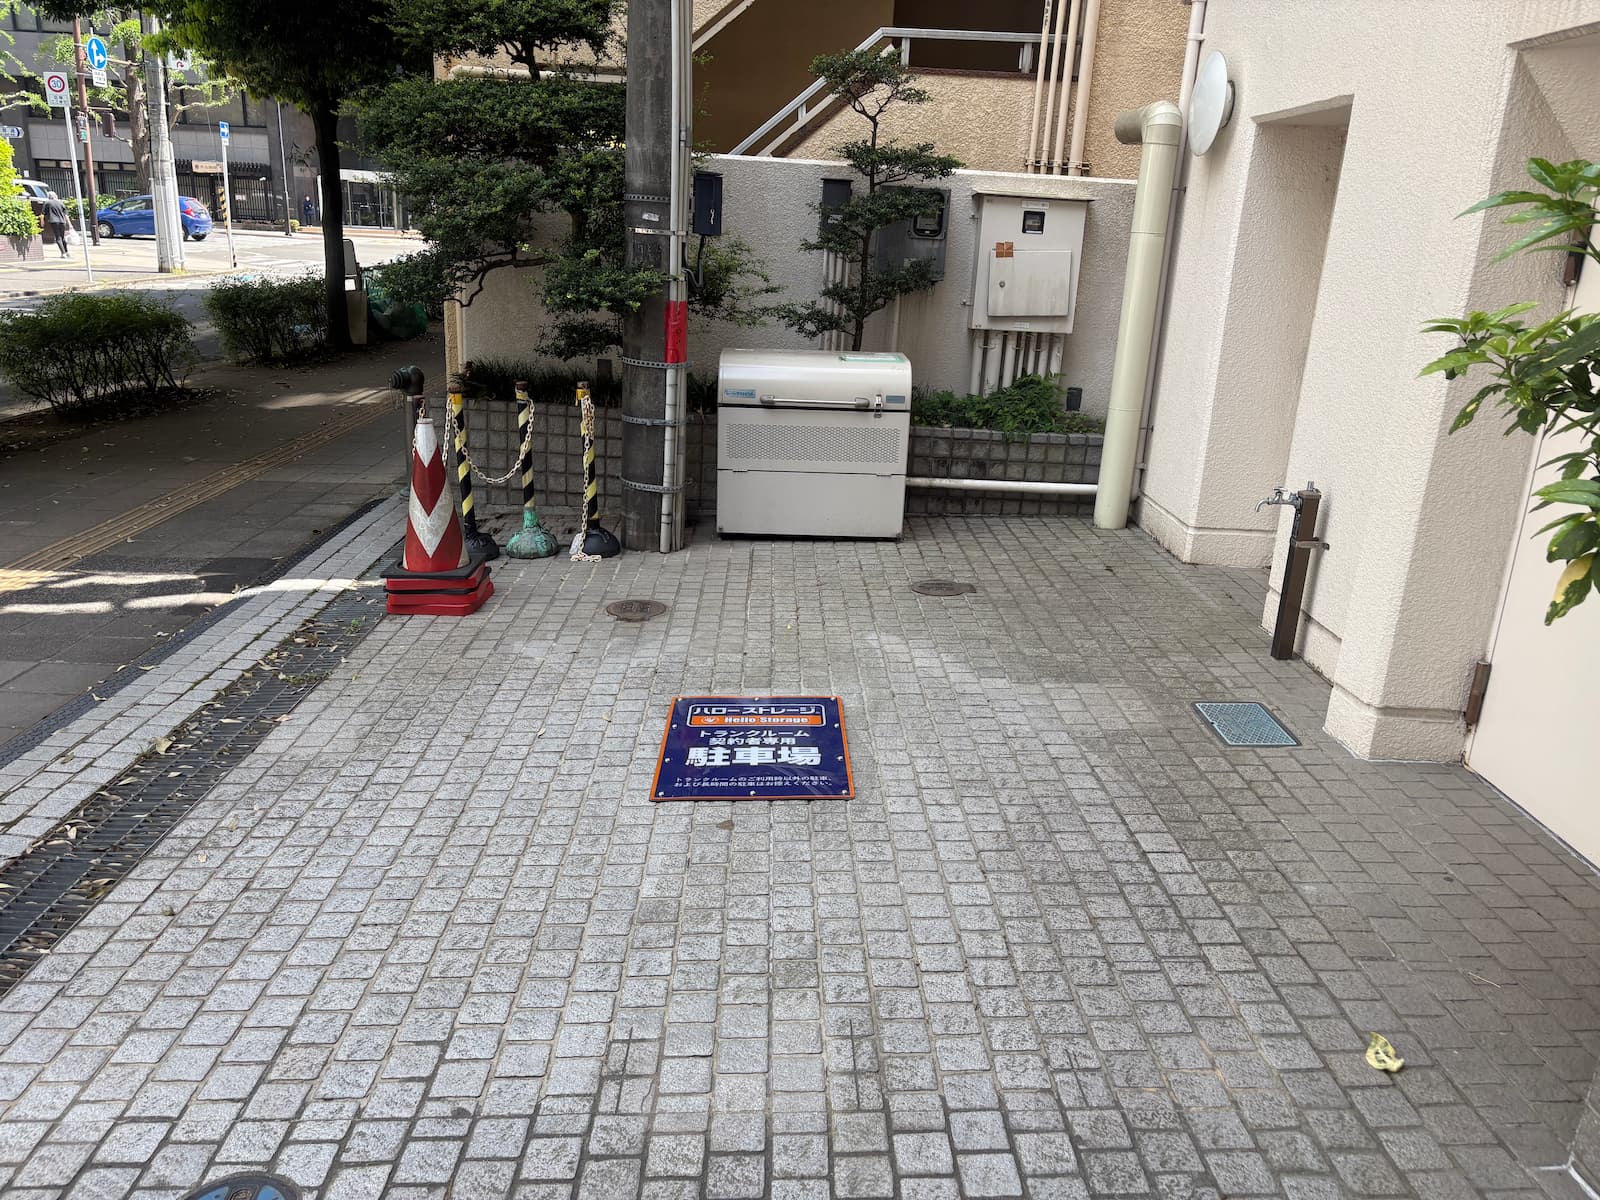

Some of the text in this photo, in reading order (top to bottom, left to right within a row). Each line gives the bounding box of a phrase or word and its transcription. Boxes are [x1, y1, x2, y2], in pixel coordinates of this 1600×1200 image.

[51, 79, 61, 88] 30
[693, 706, 816, 715] ハローストレージ
[724, 716, 809, 724] Hello Storage
[699, 730, 810, 738] トランクルーム
[708, 737, 796, 746] 契約者専用
[685, 746, 822, 766] 駐車場
